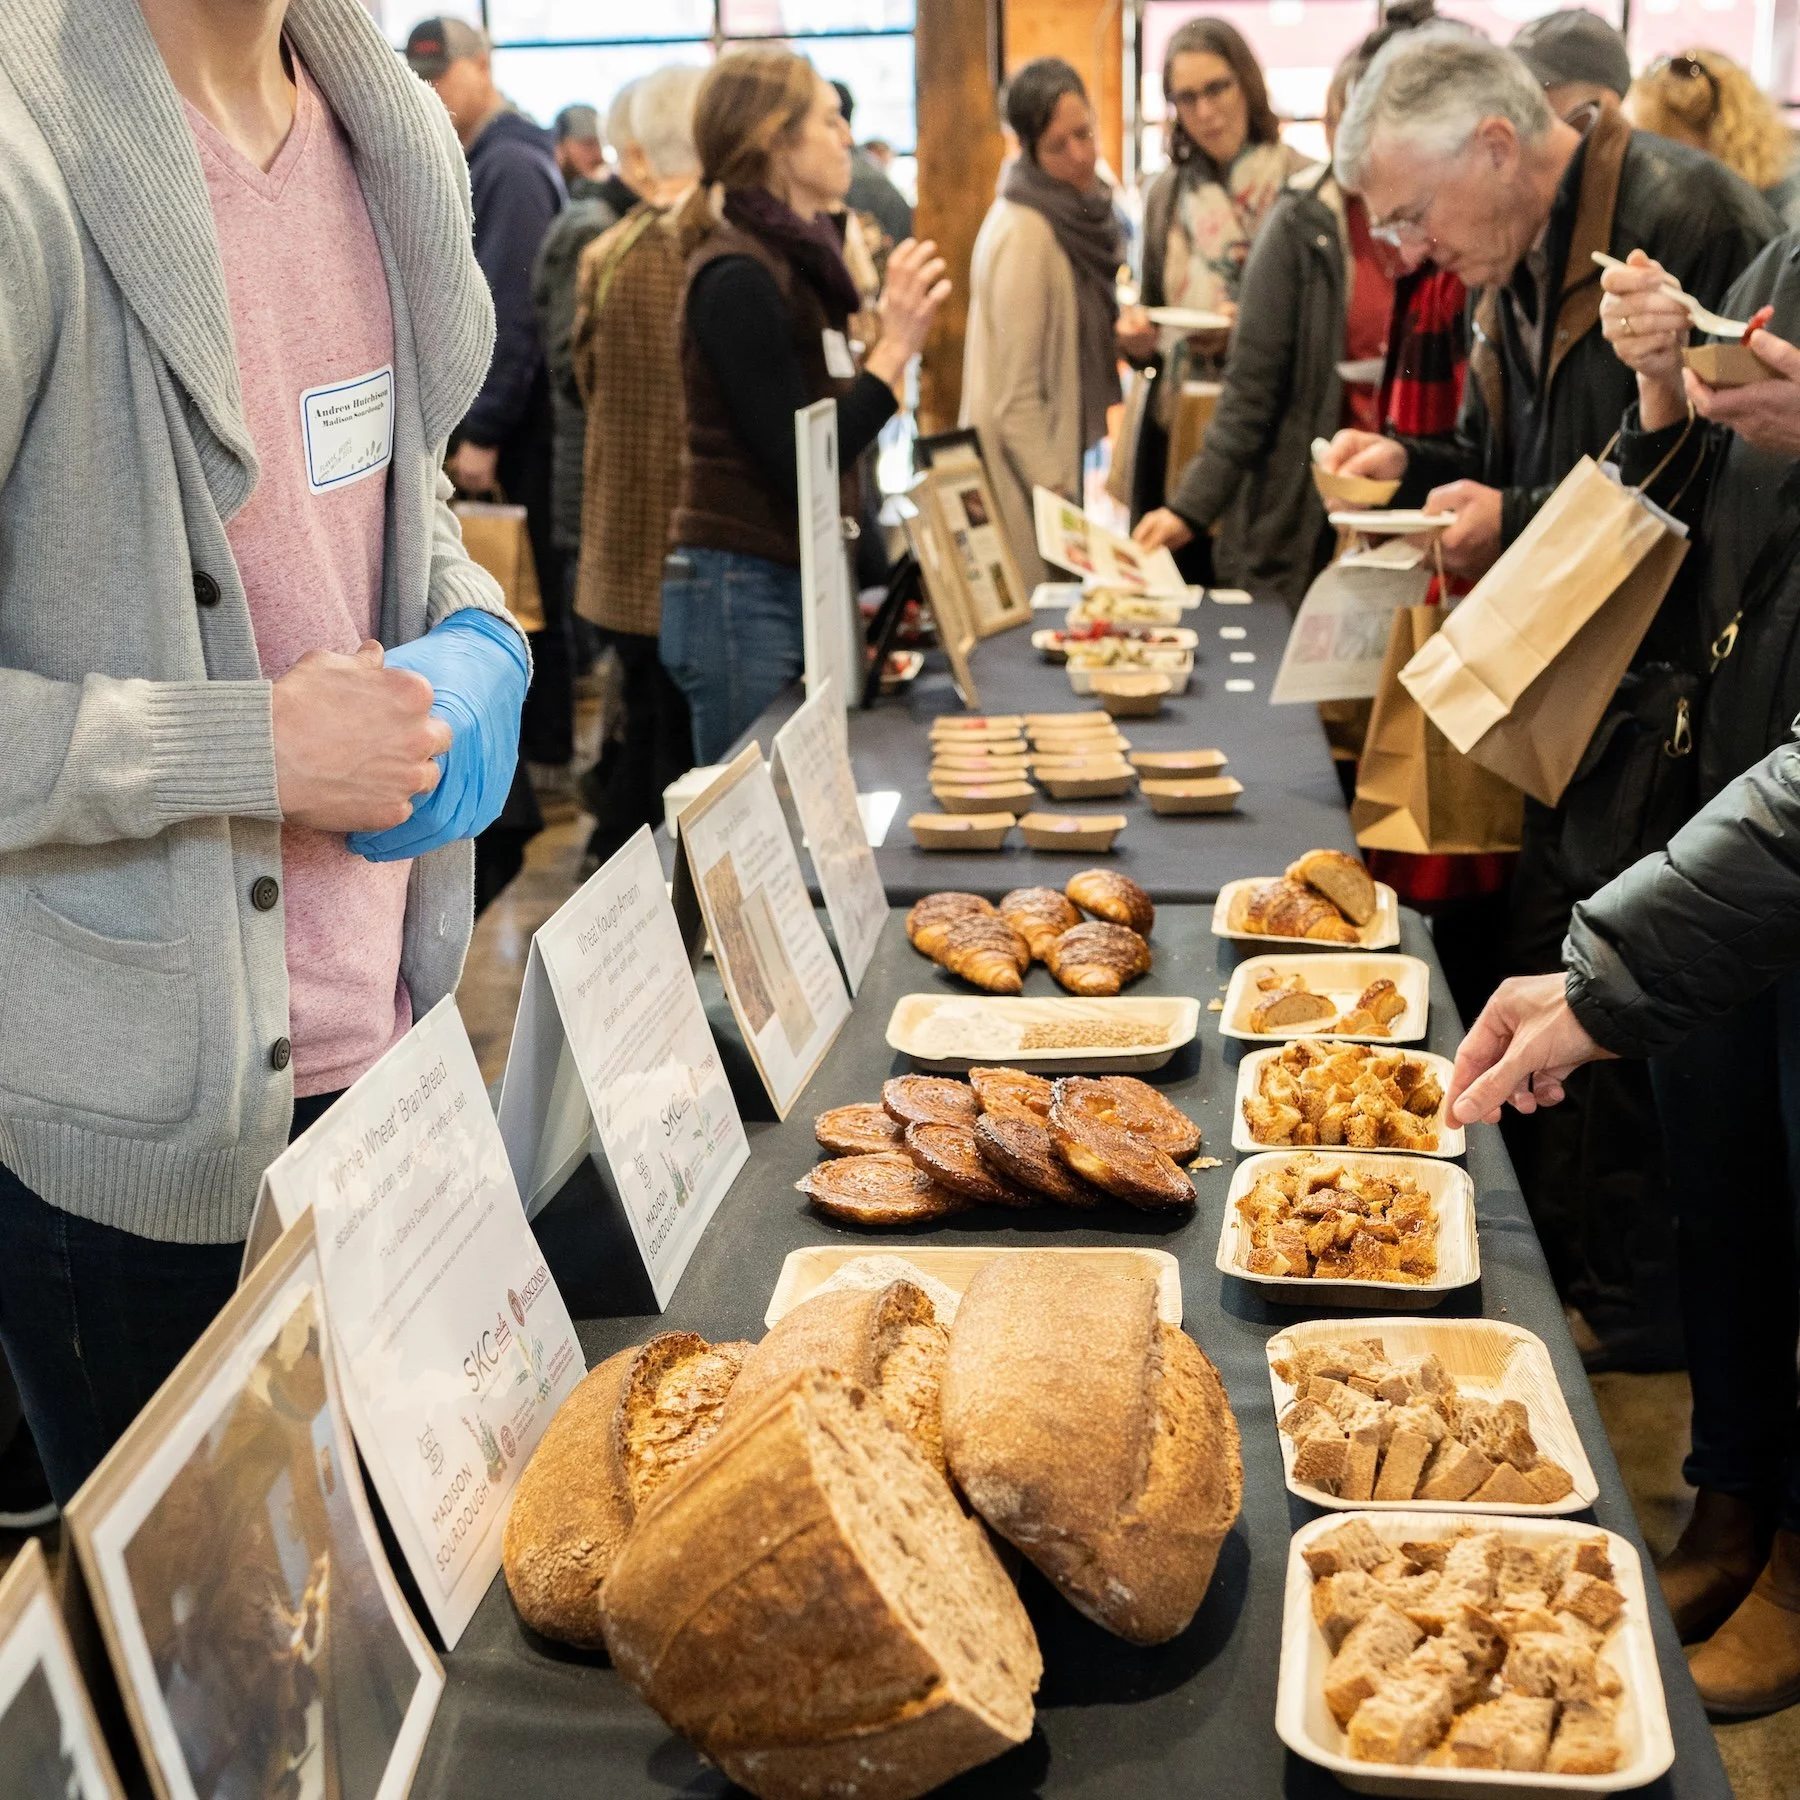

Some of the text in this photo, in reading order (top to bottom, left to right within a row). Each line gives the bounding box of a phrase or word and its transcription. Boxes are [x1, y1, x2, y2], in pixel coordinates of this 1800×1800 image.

[314, 389, 388, 419] Andrew Hutchison
[322, 402, 384, 428] Madison Sourdough
[576, 883, 640, 956] Wheat Kouign Amann
[398, 1088, 423, 1123] Bran
[419, 1055, 447, 1100] Bread
[453, 1090, 466, 1113] salt
[659, 1092, 683, 1137] SKC
[645, 1186, 669, 1230] MADISON
[649, 1205, 679, 1260] SOURDOUGH
[519, 1265, 549, 1305] WISCONSIN
[463, 1330, 499, 1393] SKC
[431, 1462, 473, 1533] MADISON
[436, 1479, 490, 1572] SOURDOUGH
